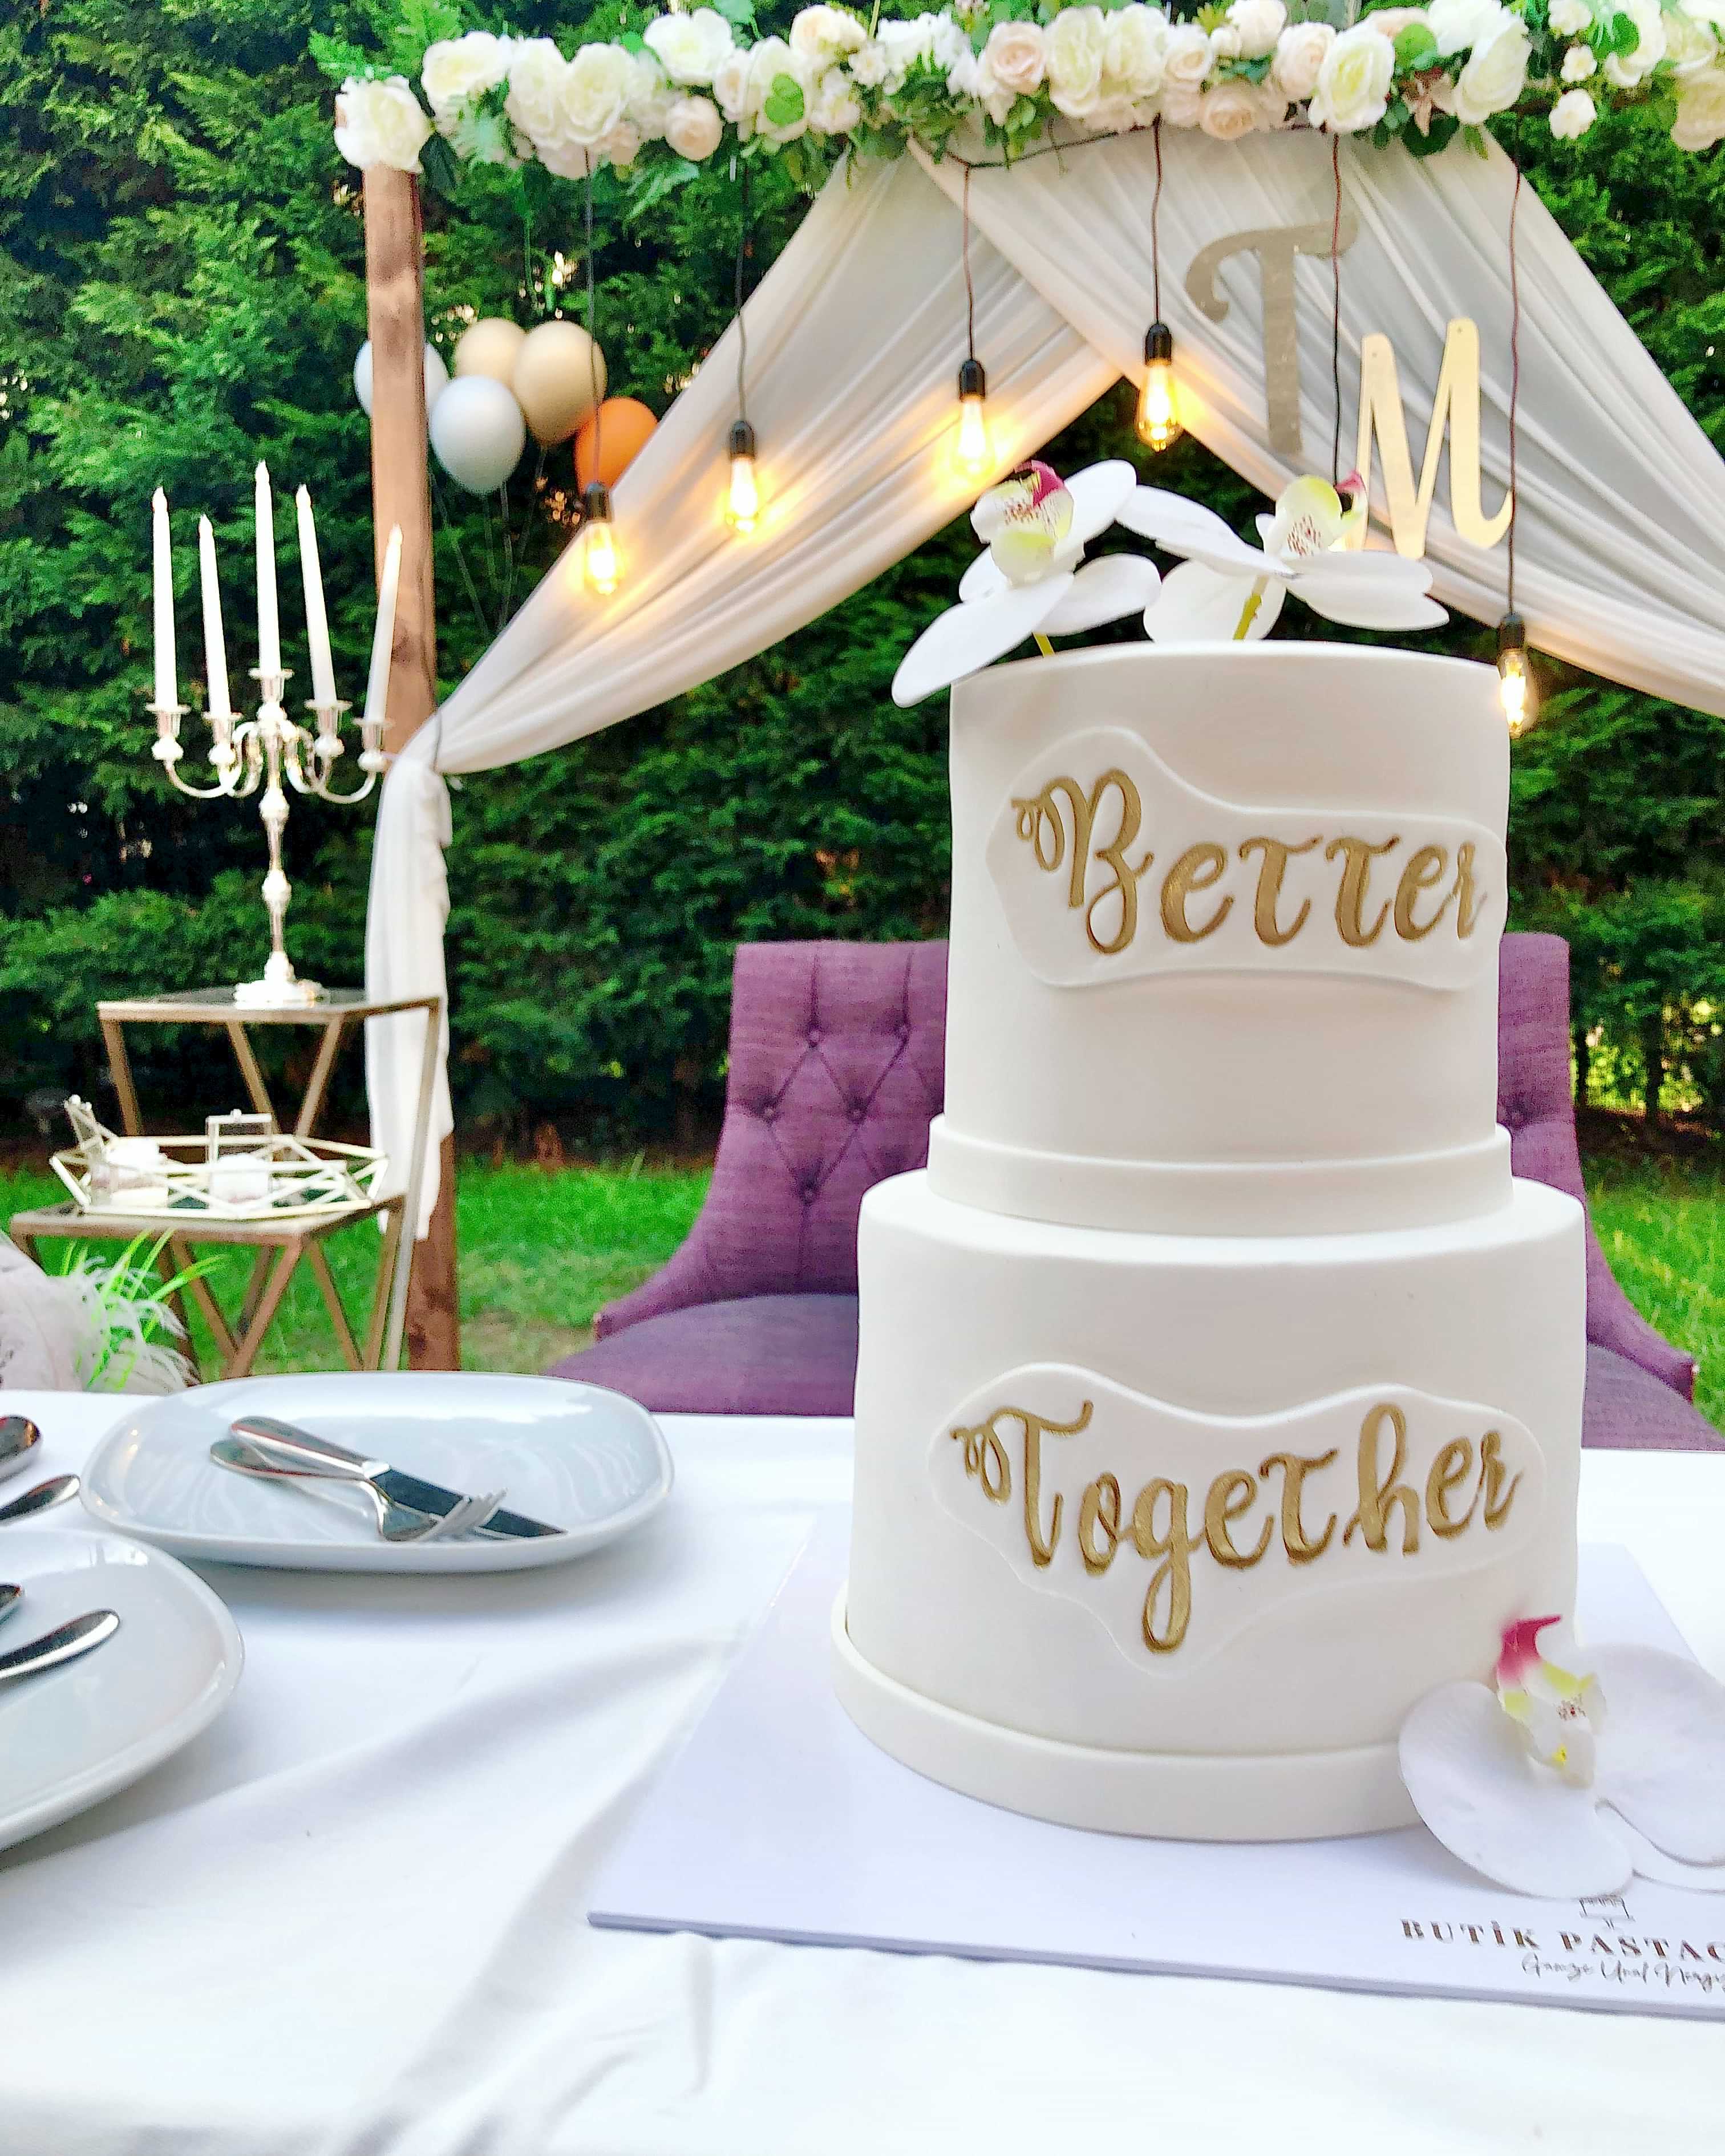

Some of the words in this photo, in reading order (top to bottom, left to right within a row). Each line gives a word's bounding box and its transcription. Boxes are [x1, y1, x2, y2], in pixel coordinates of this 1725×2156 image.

[1185, 214, 1360, 456] T
[1329, 317, 1513, 560] M
[1011, 759, 1487, 955] Better
[951, 1400, 1523, 1655] Together
